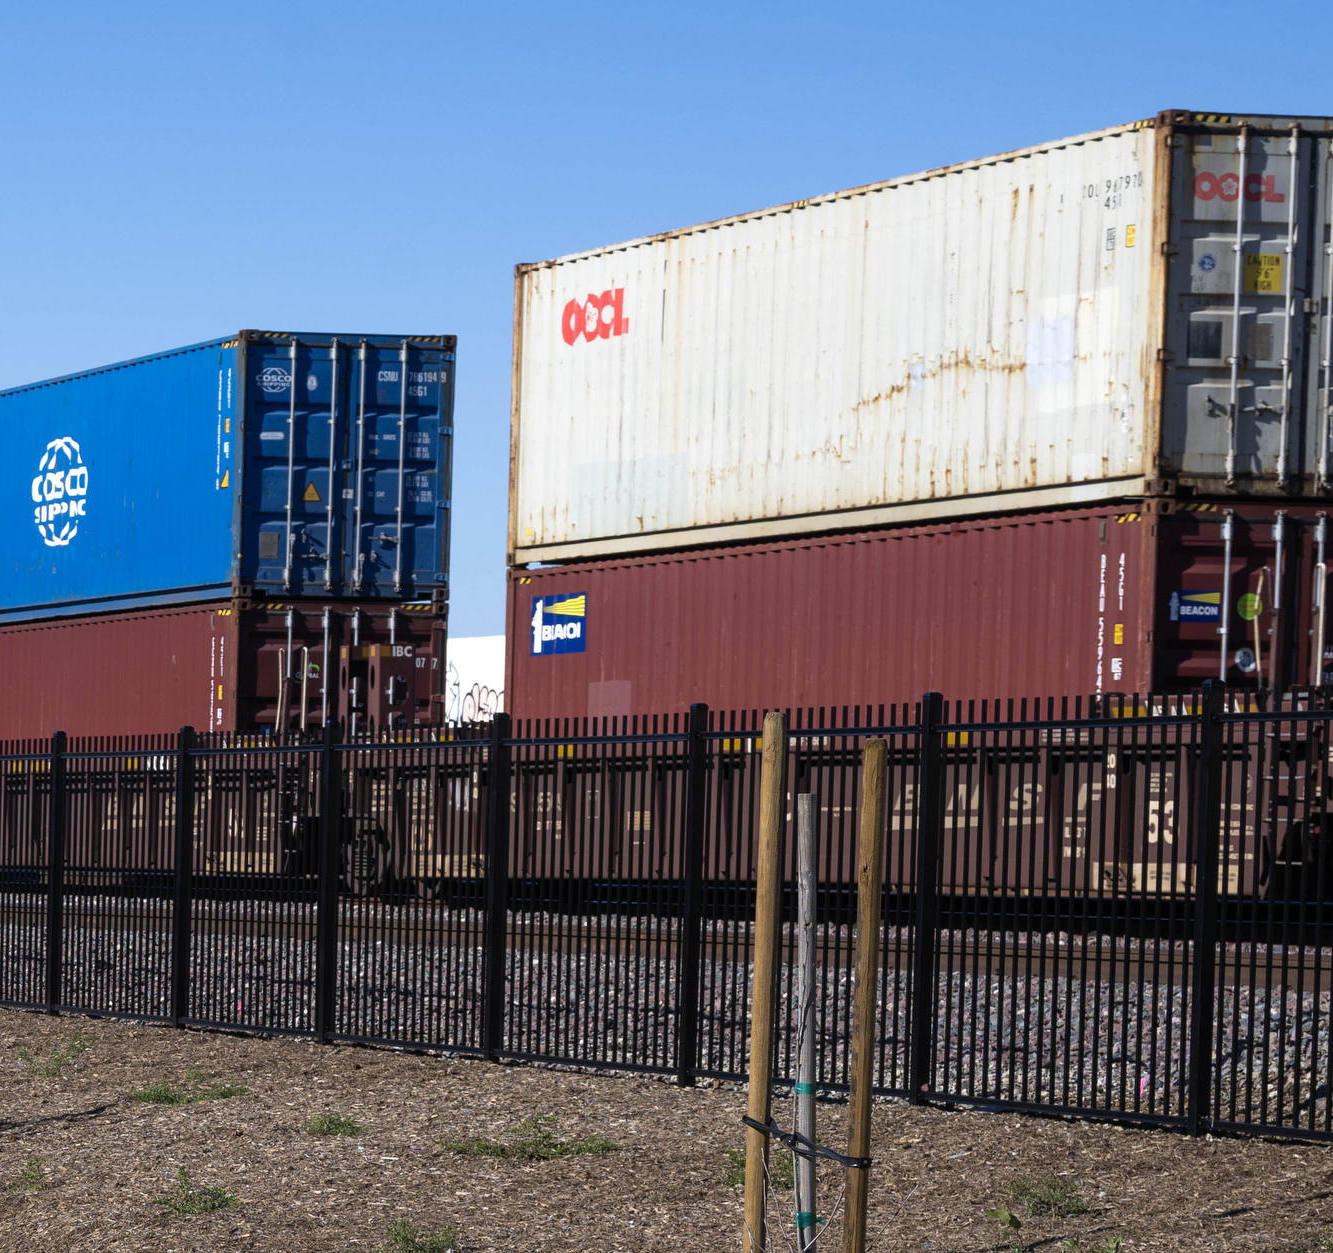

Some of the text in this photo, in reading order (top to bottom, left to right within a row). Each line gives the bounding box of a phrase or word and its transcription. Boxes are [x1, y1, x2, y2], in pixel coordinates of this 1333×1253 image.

[1194, 171, 1286, 204] OOCL
[255, 374, 293, 383] COSCO
[377, 370, 400, 382] CSNU
[31, 466, 89, 503] COSCO
[1179, 605, 1219, 617] BEACON
[392, 645, 413, 657] IBC
